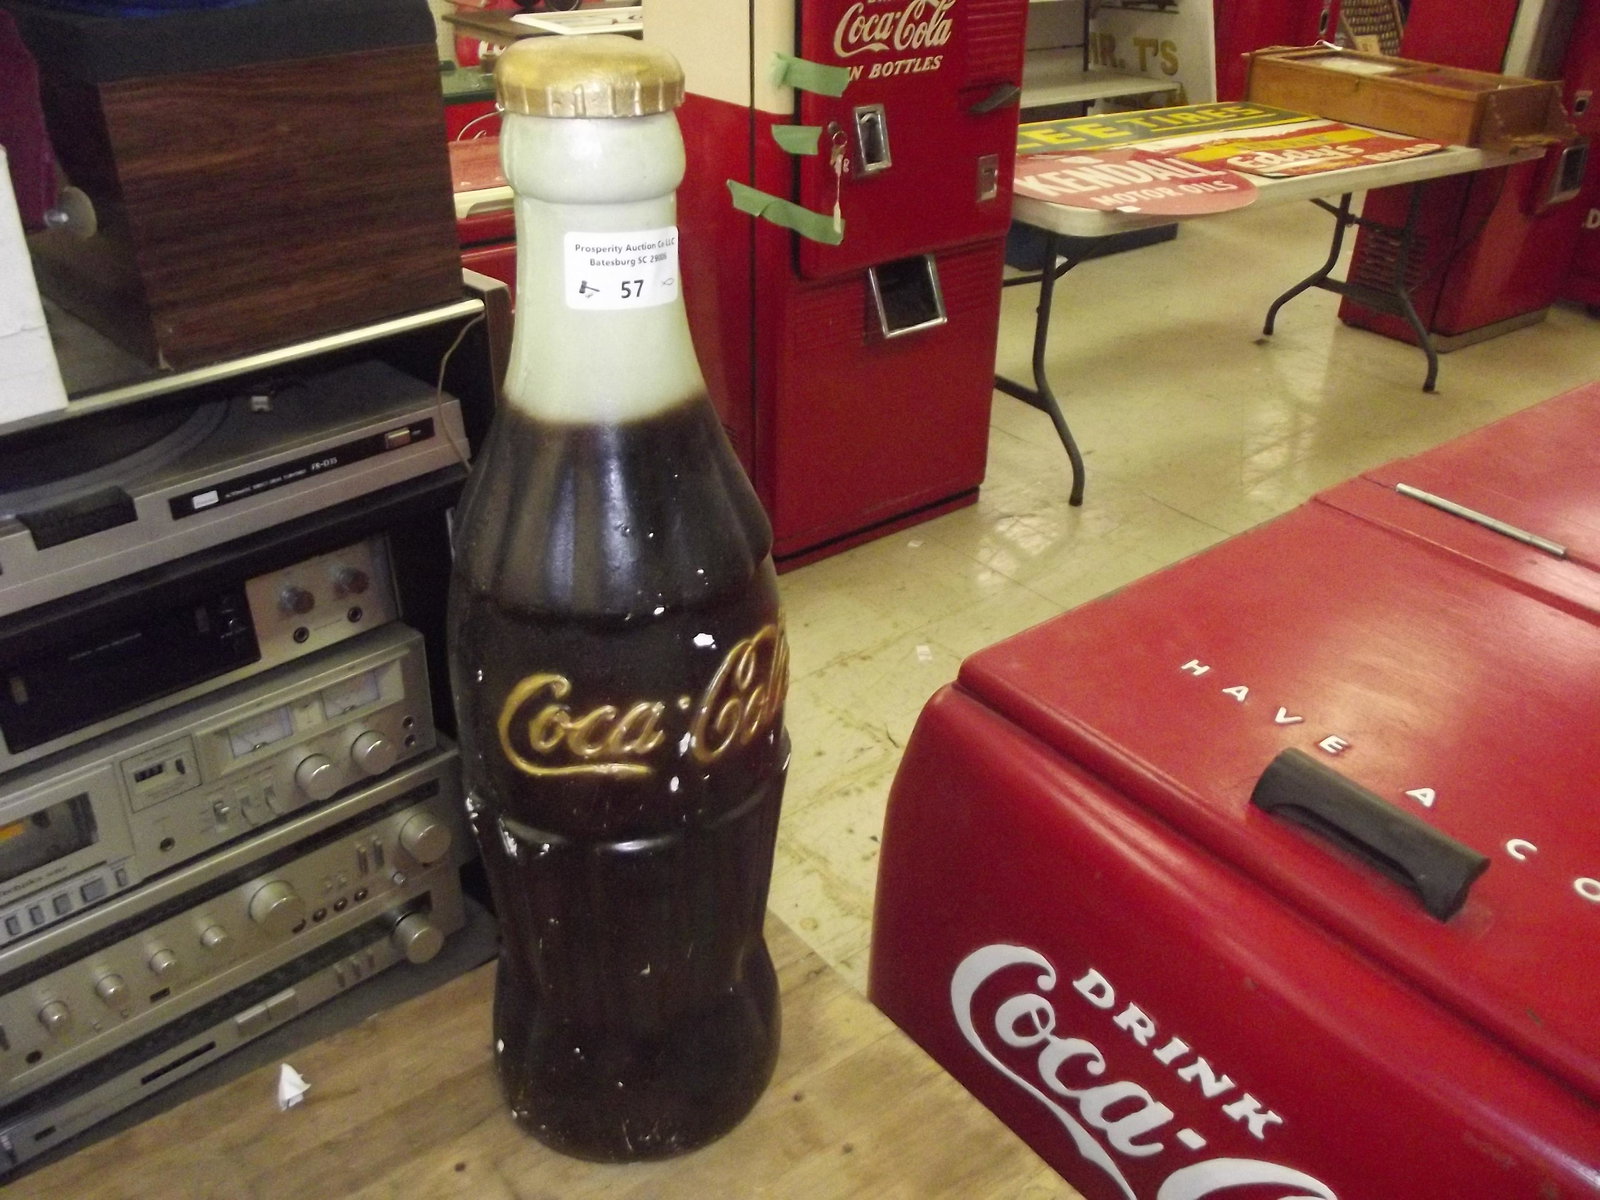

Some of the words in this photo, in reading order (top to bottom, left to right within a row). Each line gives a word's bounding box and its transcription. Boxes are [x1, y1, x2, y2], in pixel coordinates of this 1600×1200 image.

[834, 0, 957, 58] Coca-Cola
[847, 65, 864, 81] N
[868, 55, 943, 79] BOTTLES
[1116, 106, 1265, 129] TIRES
[1014, 157, 1228, 197] KENDALL
[1091, 186, 1178, 207] MOTOR
[1178, 180, 1239, 194] OILS
[575, 243, 623, 254] Prosperity
[626, 242, 657, 252] Auction
[589, 258, 636, 267] Batesburg
[638, 255, 648, 264] SC
[621, 279, 645, 299] 57
[1180, 659, 1351, 755] HAVE
[1405, 787, 1437, 808] A
[1072, 967, 1284, 1140] DRINK
